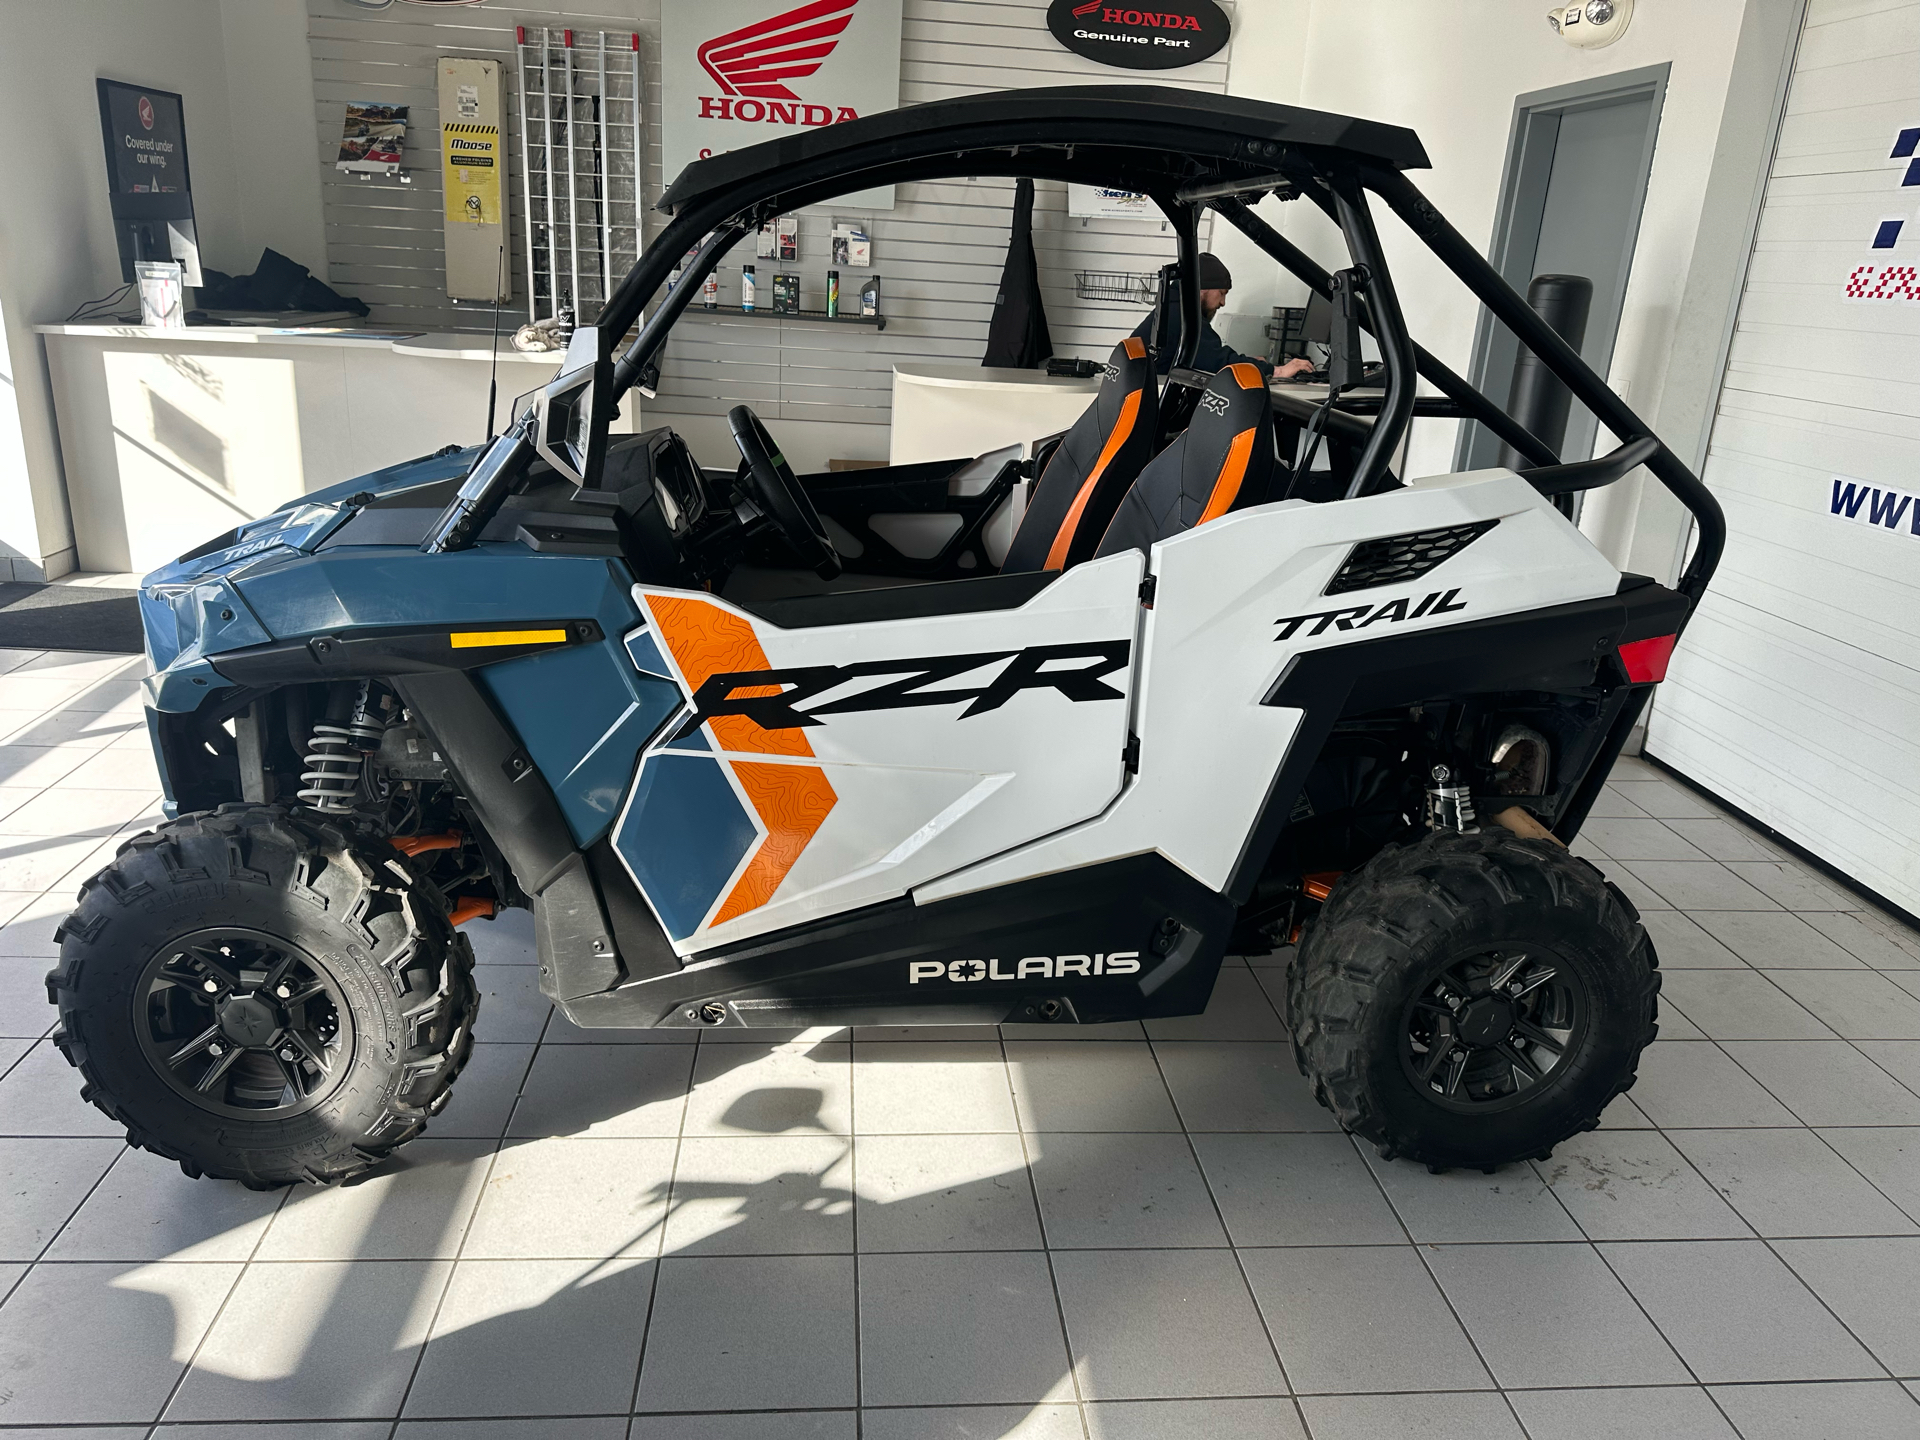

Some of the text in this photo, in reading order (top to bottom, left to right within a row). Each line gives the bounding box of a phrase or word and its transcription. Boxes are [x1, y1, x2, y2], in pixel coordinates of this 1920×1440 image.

[1101, 8, 1202, 31] HONDA
[1073, 29, 1190, 48] Genuine Part
[698, 96, 860, 127] HONDA
[125, 134, 174, 152] Covered under
[451, 138, 493, 151] Moose
[137, 152, 167, 168] our wing.
[1830, 479, 1920, 537] WW
[224, 534, 285, 561] TRAIL
[1273, 587, 1468, 642] TRAIL
[351, 679, 371, 722] FOX
[667, 638, 1132, 739] RZR
[909, 951, 1142, 984] POLARIS
